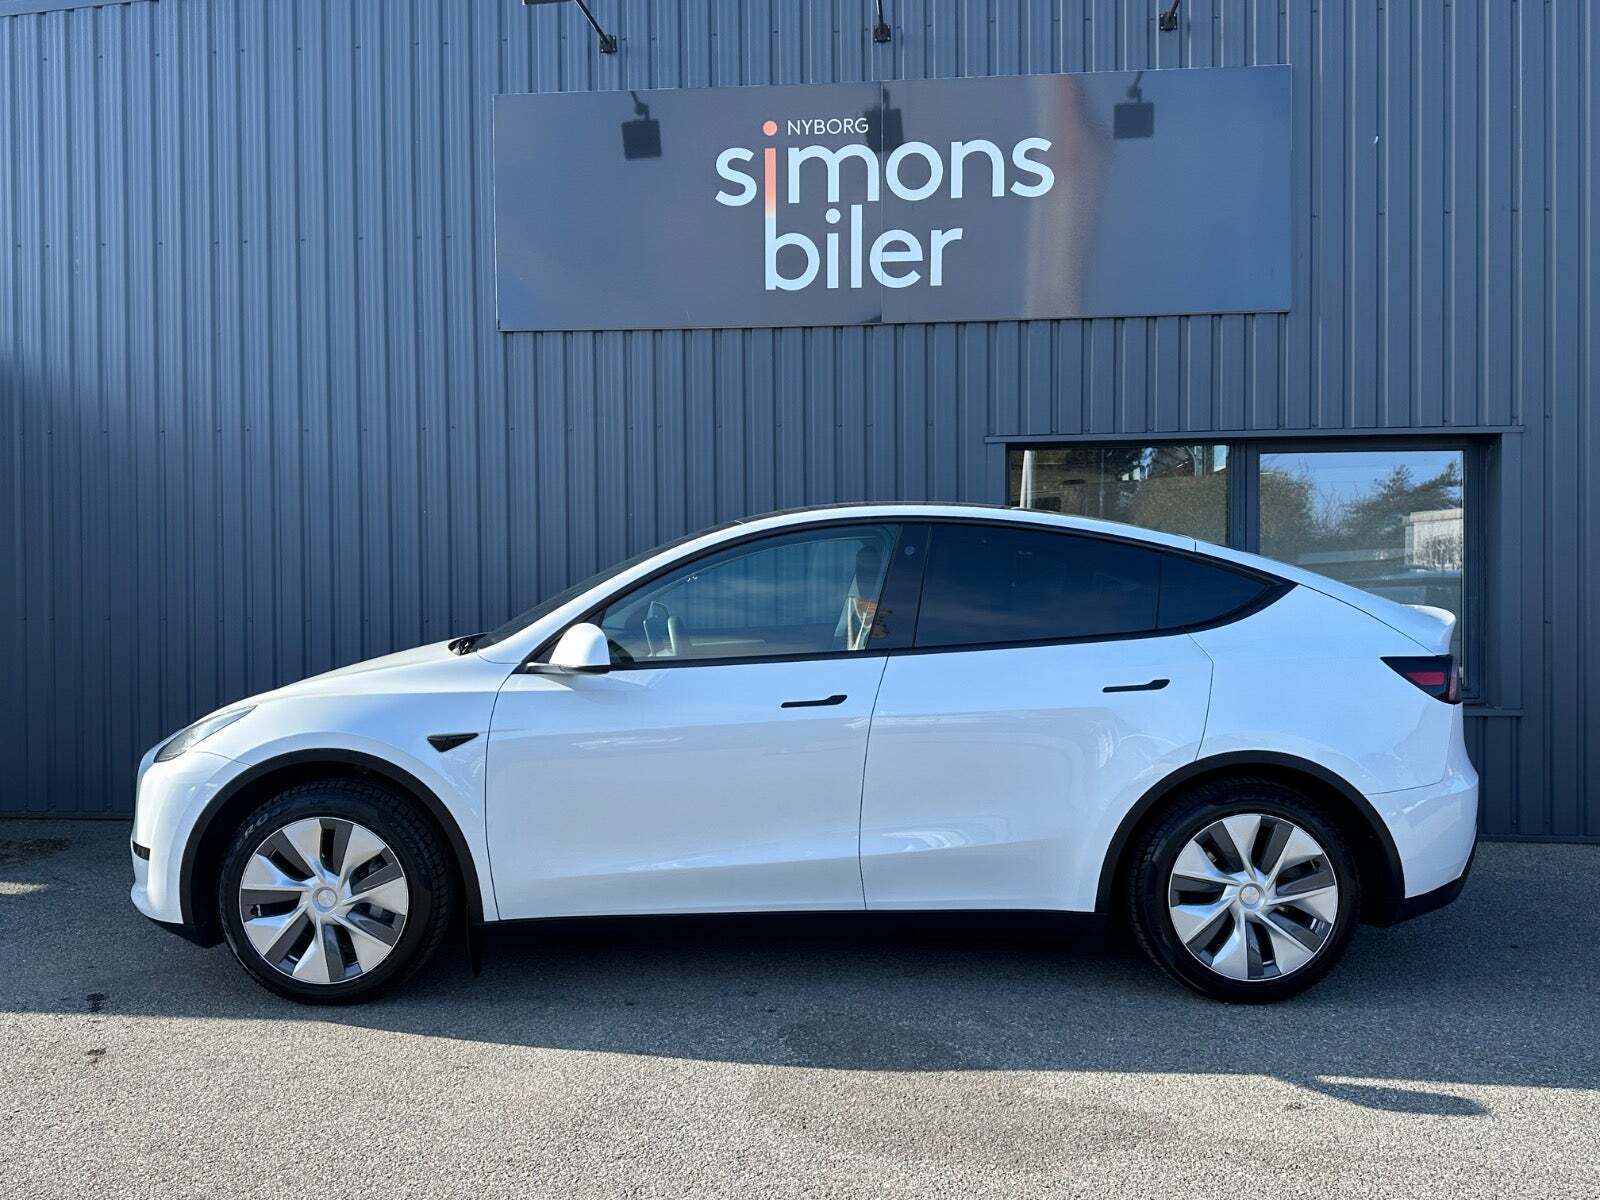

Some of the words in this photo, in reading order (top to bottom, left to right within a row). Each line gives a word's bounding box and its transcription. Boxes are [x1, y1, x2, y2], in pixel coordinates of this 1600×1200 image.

[714, 120, 1055, 208] simons
[787, 117, 869, 136] NYBORG
[764, 203, 963, 292] biler
